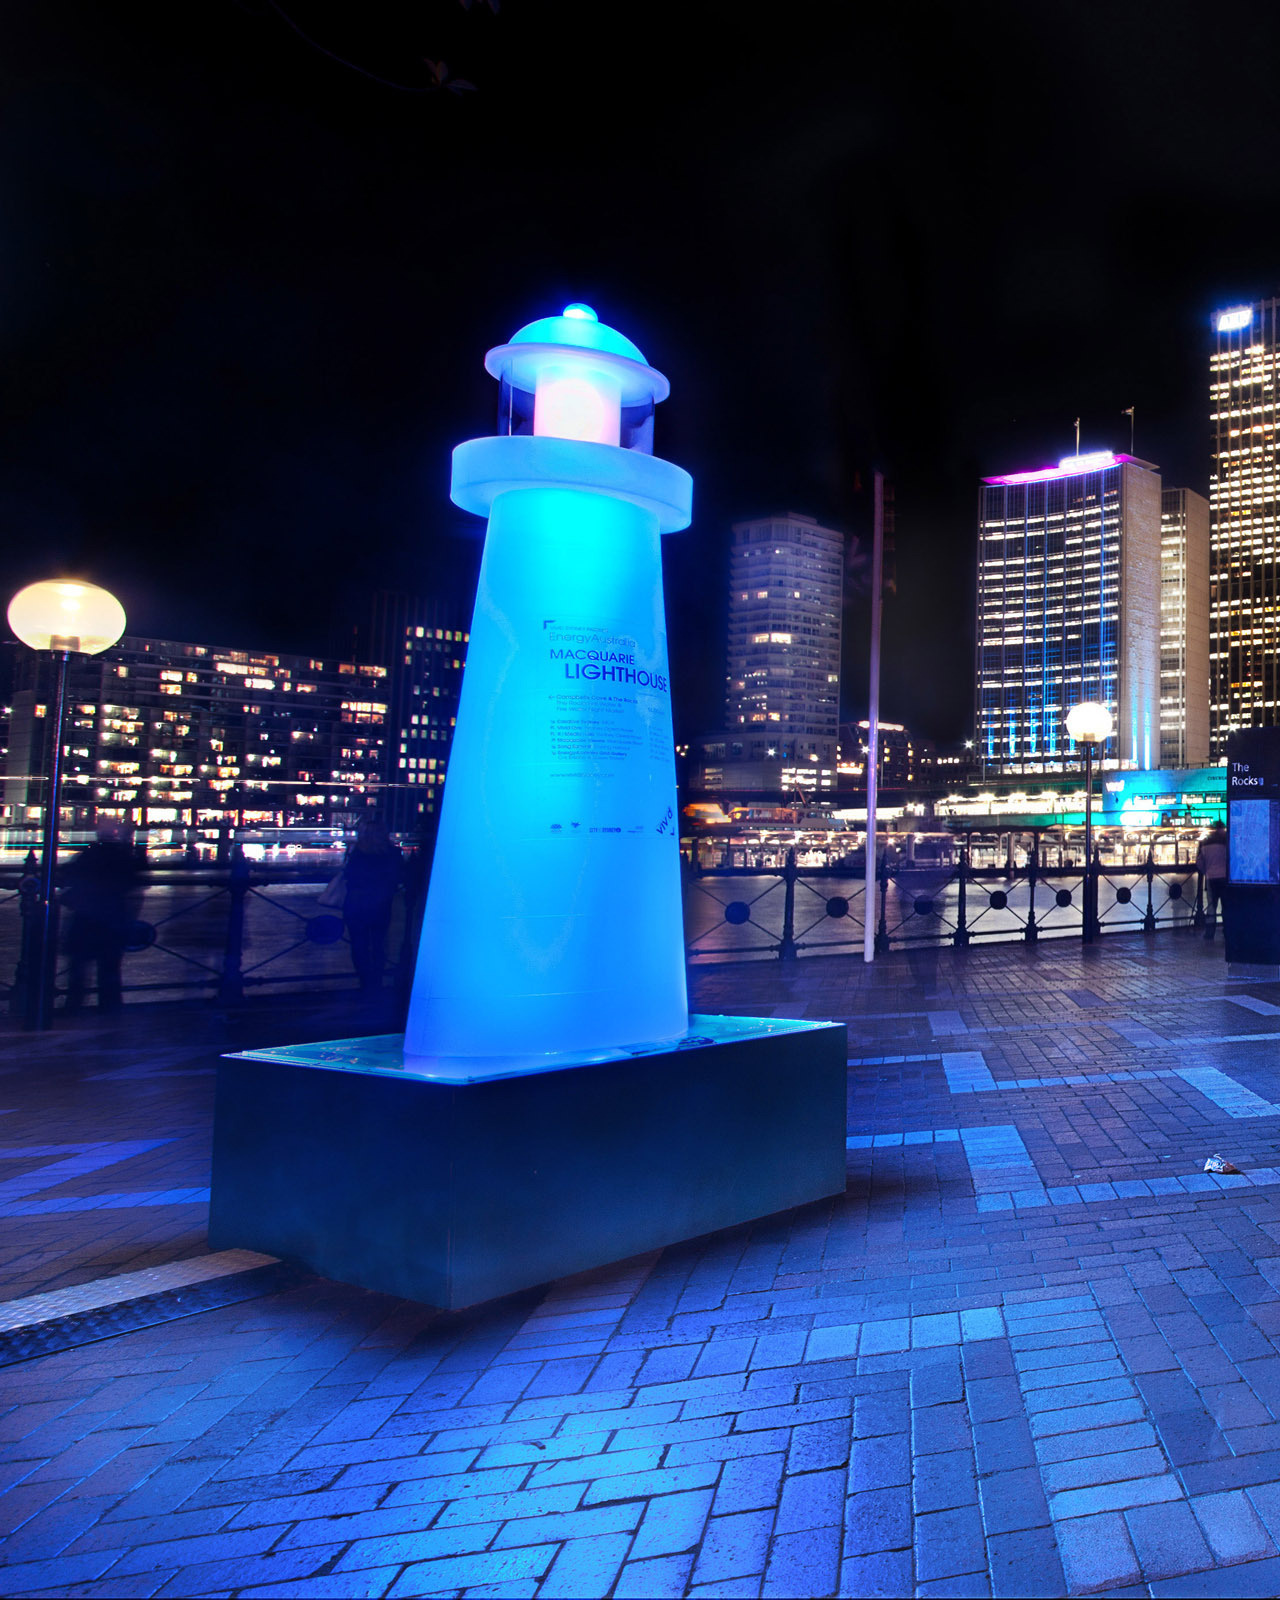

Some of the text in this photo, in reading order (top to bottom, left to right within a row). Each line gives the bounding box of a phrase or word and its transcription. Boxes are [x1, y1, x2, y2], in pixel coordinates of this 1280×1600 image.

[549, 632, 636, 647] EnergyAustralia
[550, 649, 635, 665] MACQUARIE
[565, 663, 668, 693] LIGHTHOUSE
[1231, 762, 1250, 772] The
[1231, 775, 1259, 786] Rocks
